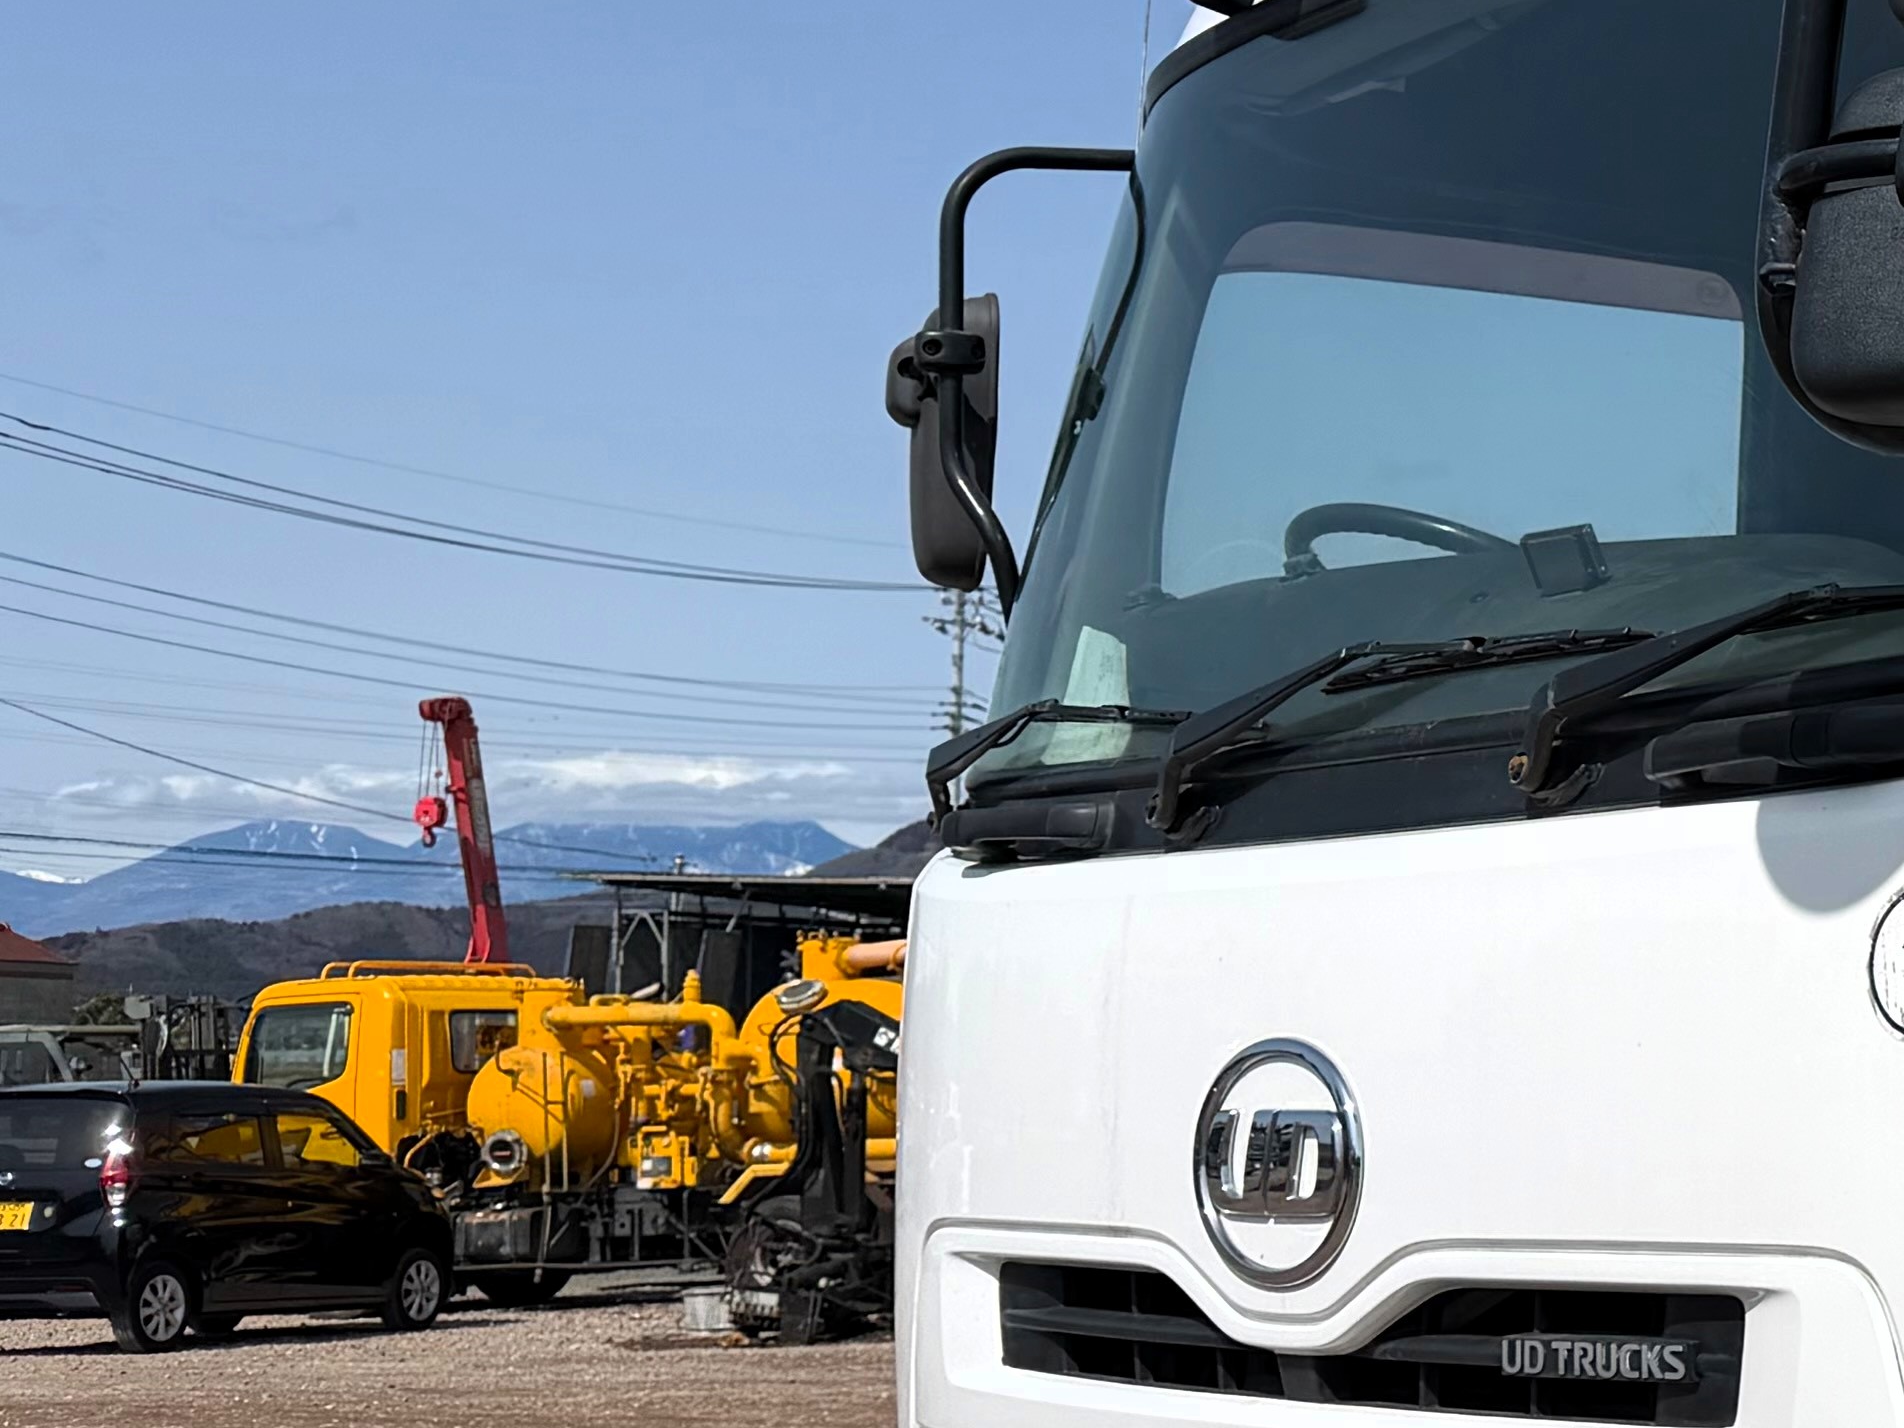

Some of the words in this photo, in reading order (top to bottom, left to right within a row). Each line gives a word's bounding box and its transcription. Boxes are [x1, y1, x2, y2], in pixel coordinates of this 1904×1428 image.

[1206, 1108, 1345, 1225] UD
[1501, 1339, 1544, 1375] UD
[1550, 1339, 1687, 1381] TRUCKS
